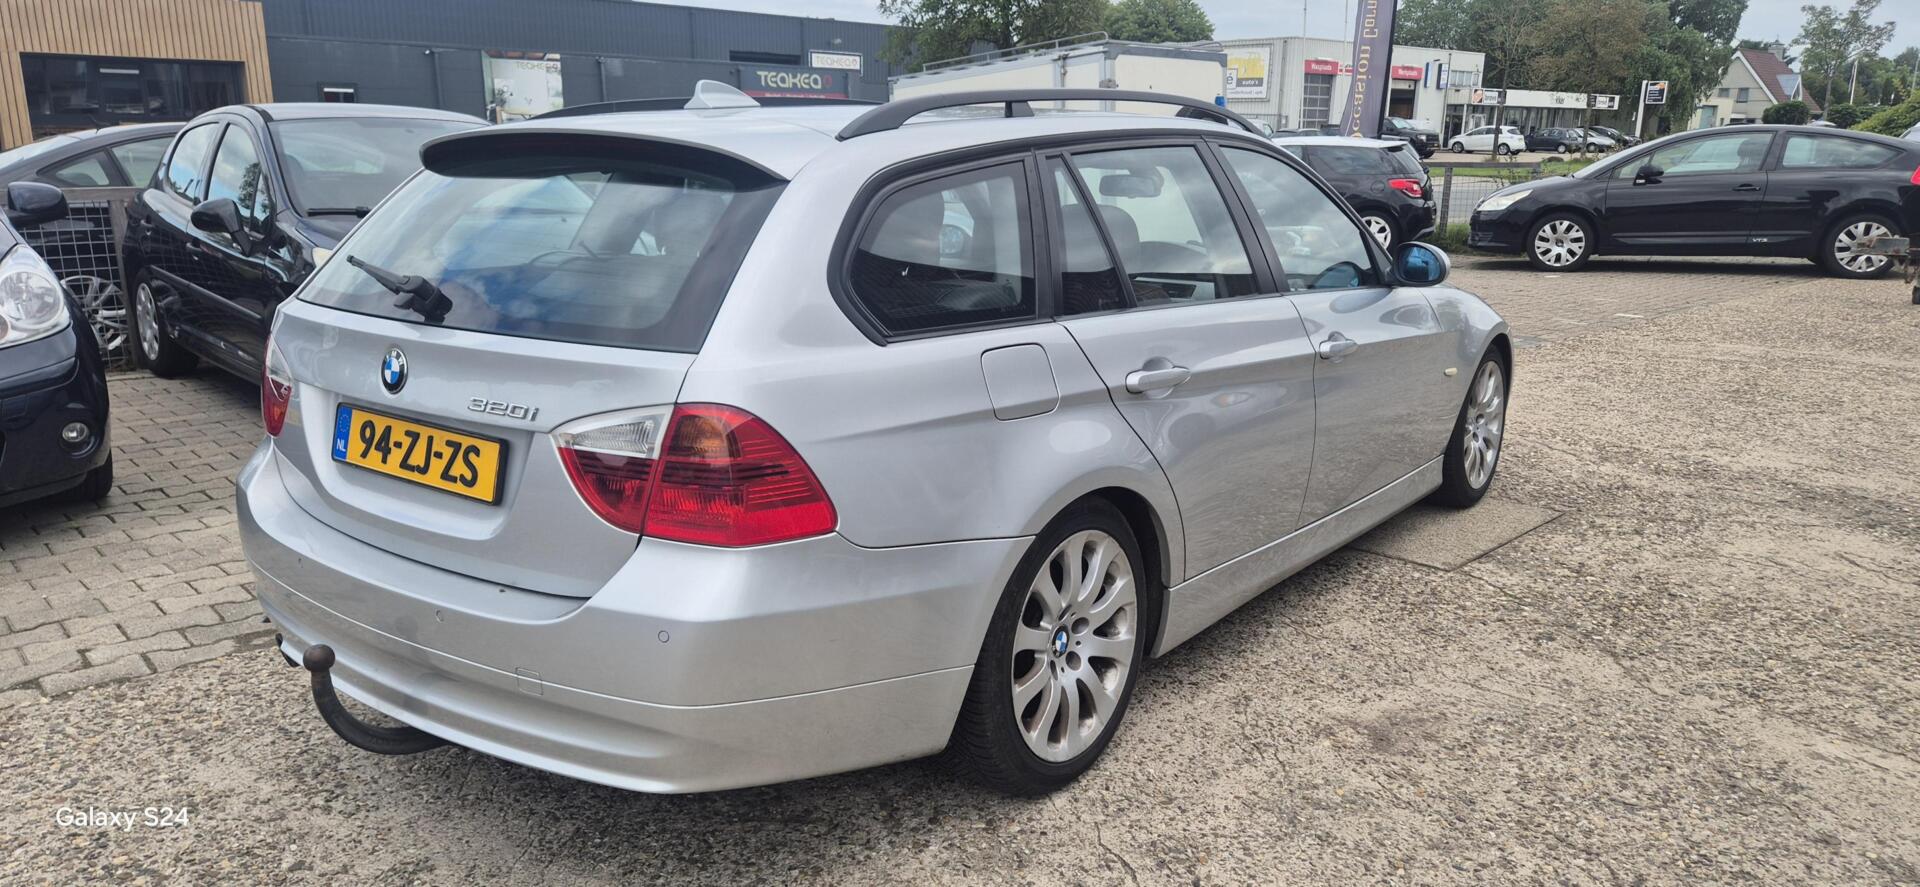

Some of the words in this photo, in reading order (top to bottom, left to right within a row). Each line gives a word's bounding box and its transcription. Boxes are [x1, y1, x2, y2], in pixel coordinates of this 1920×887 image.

[467, 396, 539, 422] 320i
[336, 439, 346, 453] NL
[359, 419, 481, 489] 94-ZJ-ZS
